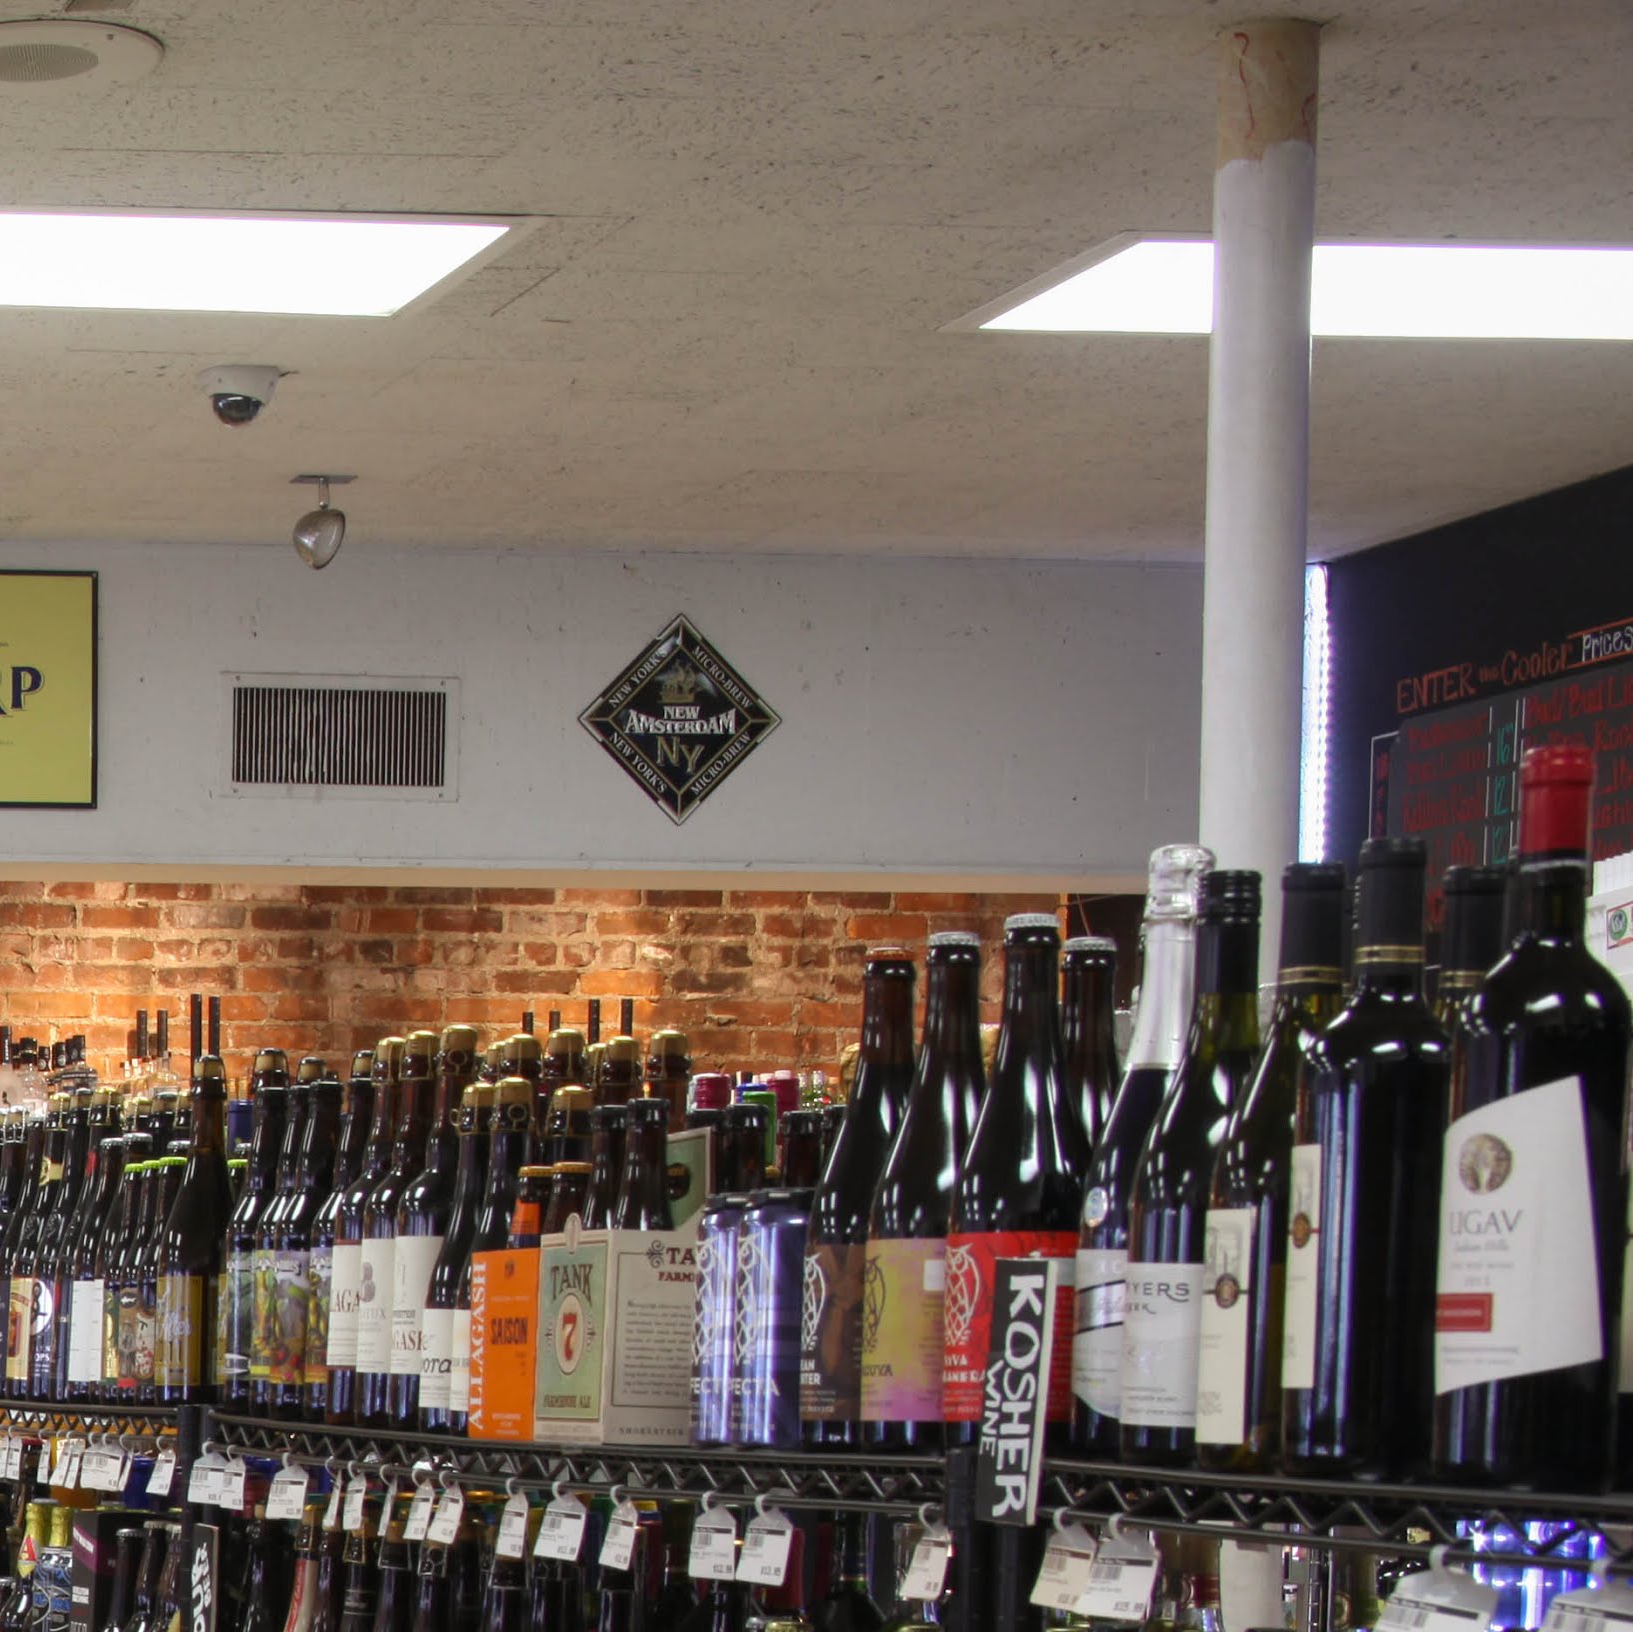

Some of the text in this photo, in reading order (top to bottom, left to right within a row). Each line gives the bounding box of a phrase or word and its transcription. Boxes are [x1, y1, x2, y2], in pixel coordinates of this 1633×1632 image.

[609, 648, 668, 708] NEW YORK'S
[692, 646, 753, 709] MICRO-BREW
[1396, 663, 1477, 713] ENTER
[1502, 642, 1573, 685] Cooler
[624, 708, 735, 734] AMSTERDAM
[663, 706, 700, 719] NEW
[609, 732, 668, 794] NEW YORK'S
[656, 736, 705, 773] NY
[691, 731, 751, 794] MICRO-BREW
[551, 1264, 594, 1302] TANK
[468, 1261, 487, 1430] ALLAGASH
[491, 1317, 528, 1344] SAISON
[562, 1314, 577, 1361] 7
[979, 1360, 1004, 1458] WINE
[992, 1274, 1046, 1518] KOSHER
